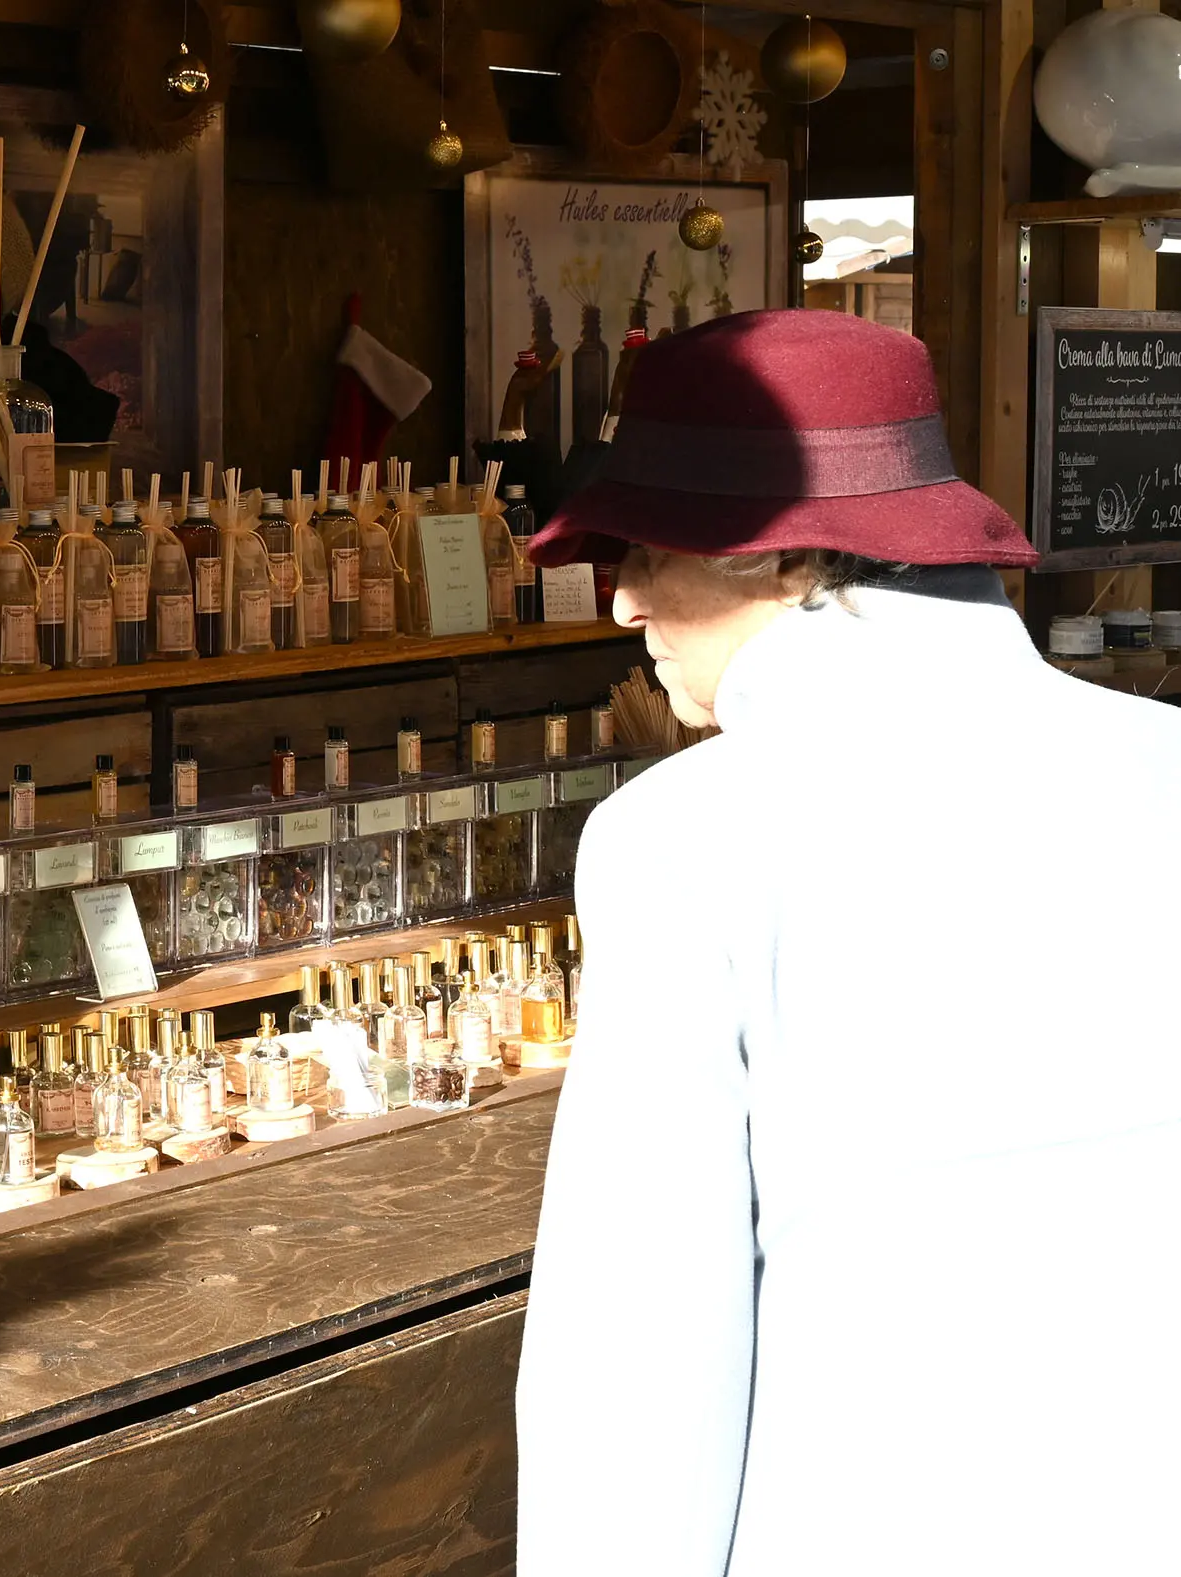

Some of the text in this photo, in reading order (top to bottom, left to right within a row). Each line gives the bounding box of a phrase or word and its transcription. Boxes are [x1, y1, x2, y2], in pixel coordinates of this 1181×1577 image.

[559, 187, 691, 224] Huiles essentiell
[1059, 338, 1094, 370] Crema
[1095, 341, 1116, 368] alla
[1116, 341, 1141, 368] bava
[1142, 342, 1153, 368] di
[1155, 467, 1159, 486] 1
[1152, 509, 1160, 529] 2
